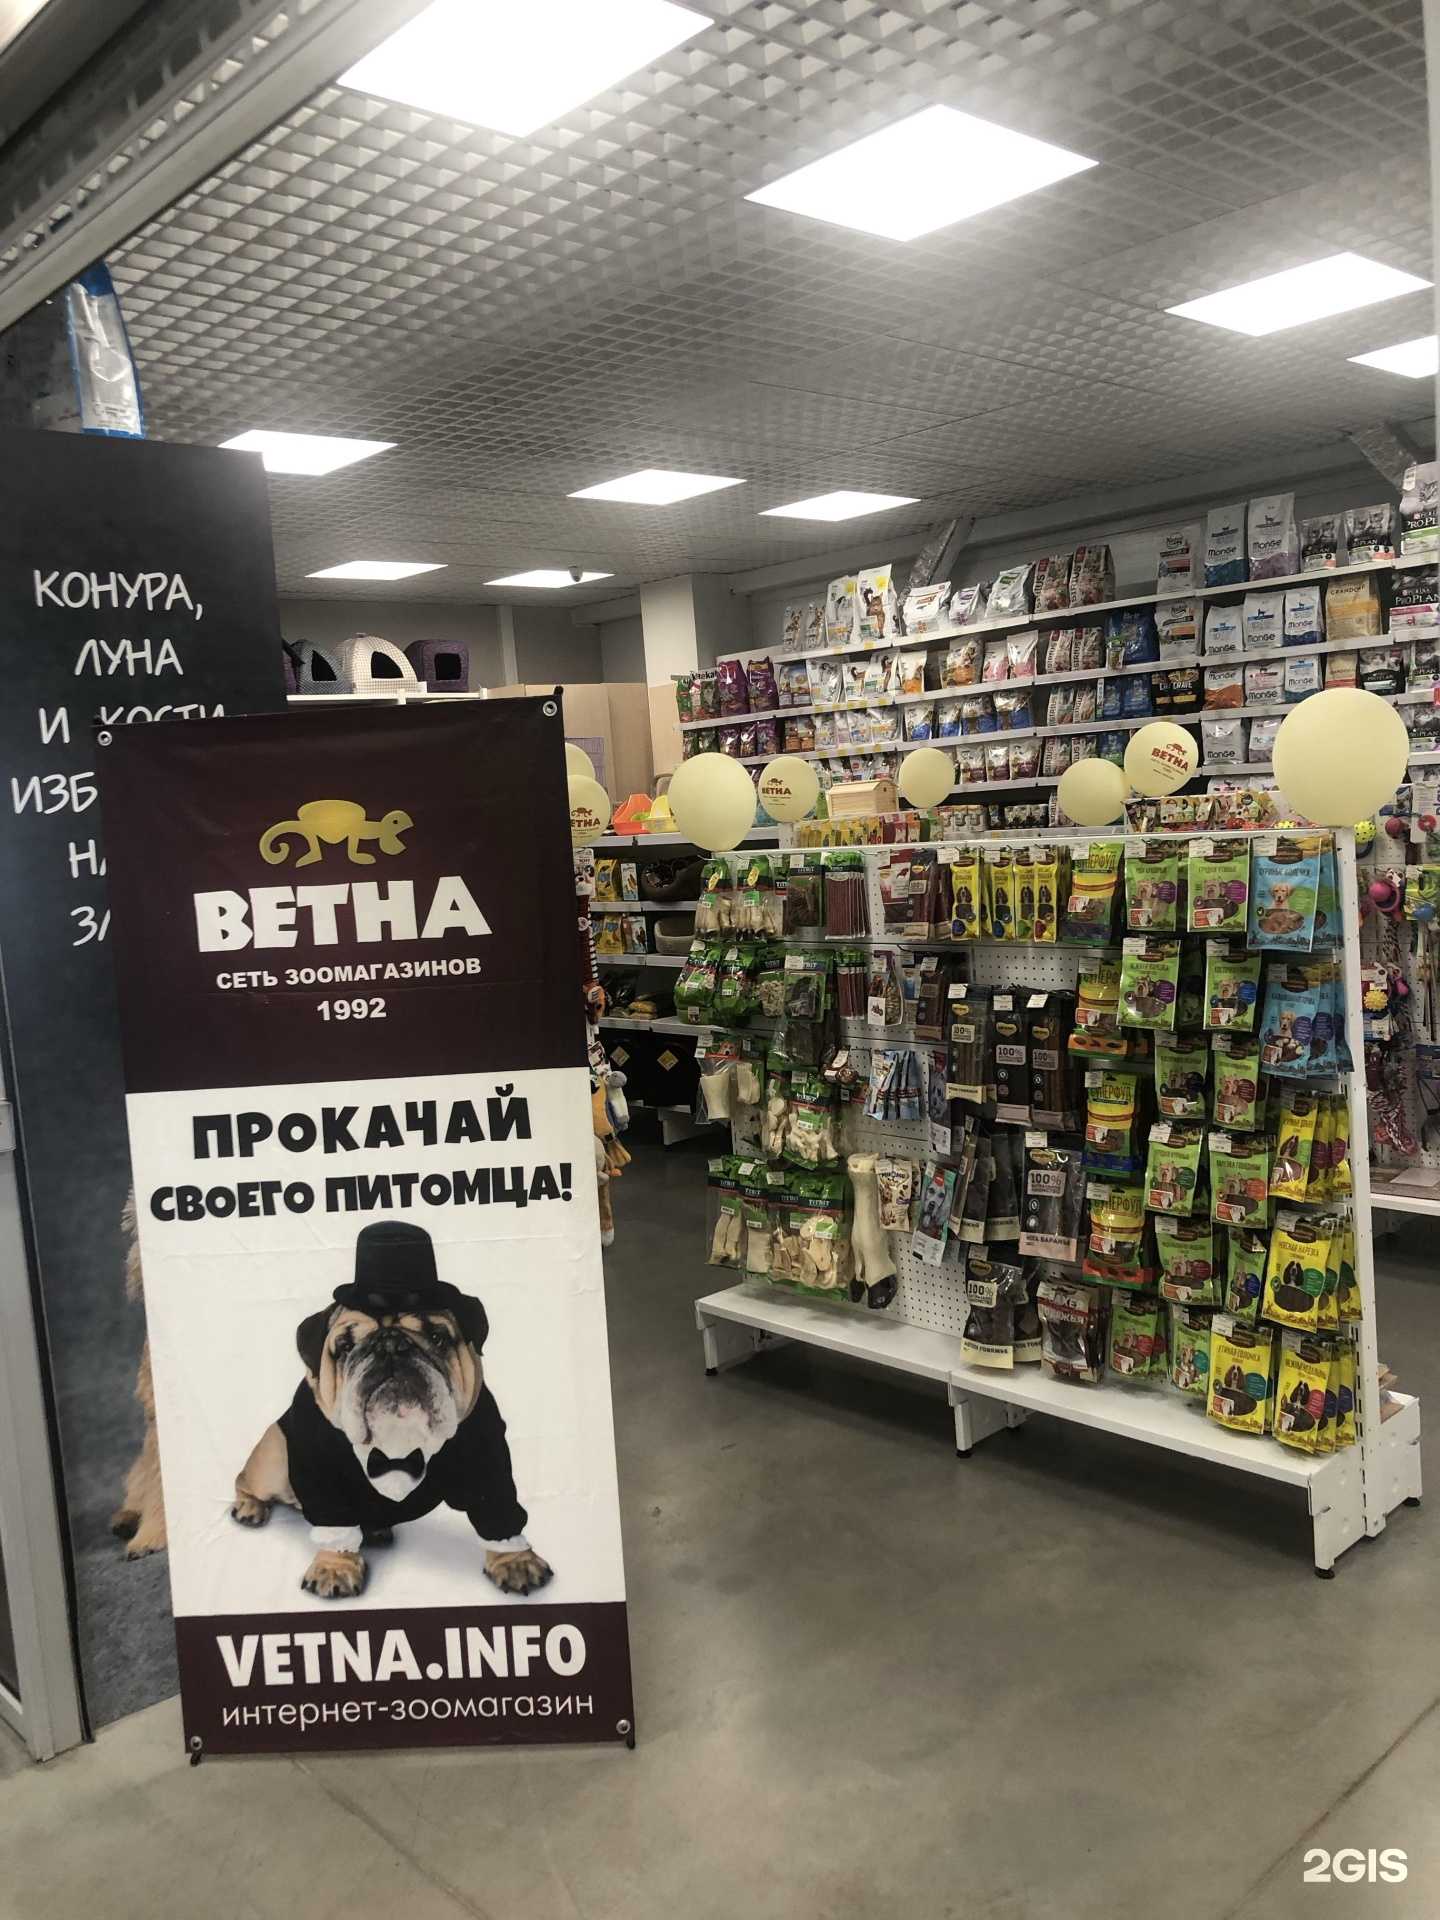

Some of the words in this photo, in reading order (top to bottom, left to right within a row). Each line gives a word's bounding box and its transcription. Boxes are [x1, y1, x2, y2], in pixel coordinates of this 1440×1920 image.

[32, 569, 203, 620] КОНУРА,
[74, 638, 184, 676] ЛУНА
[39, 706, 71, 744] И
[69, 839, 108, 879] Н
[193, 875, 492, 953] ВЕТНА
[216, 970, 278, 991] СЕТЬ
[285, 957, 482, 986] ЗООМАГАЗИНОВ
[316, 997, 388, 1022] 1992
[192, 1083, 533, 1160] ПРОКАЧАЙ
[150, 1179, 315, 1222] СВОЕГО
[325, 1162, 573, 1214] ПИТОМЦА!
[1030, 1172, 1063, 1186] 100%
[967, 1283, 994, 1297] 100%
[216, 1623, 587, 1688] VETNA.INFO
[222, 1693, 594, 1731] интернет-зоомагазин
